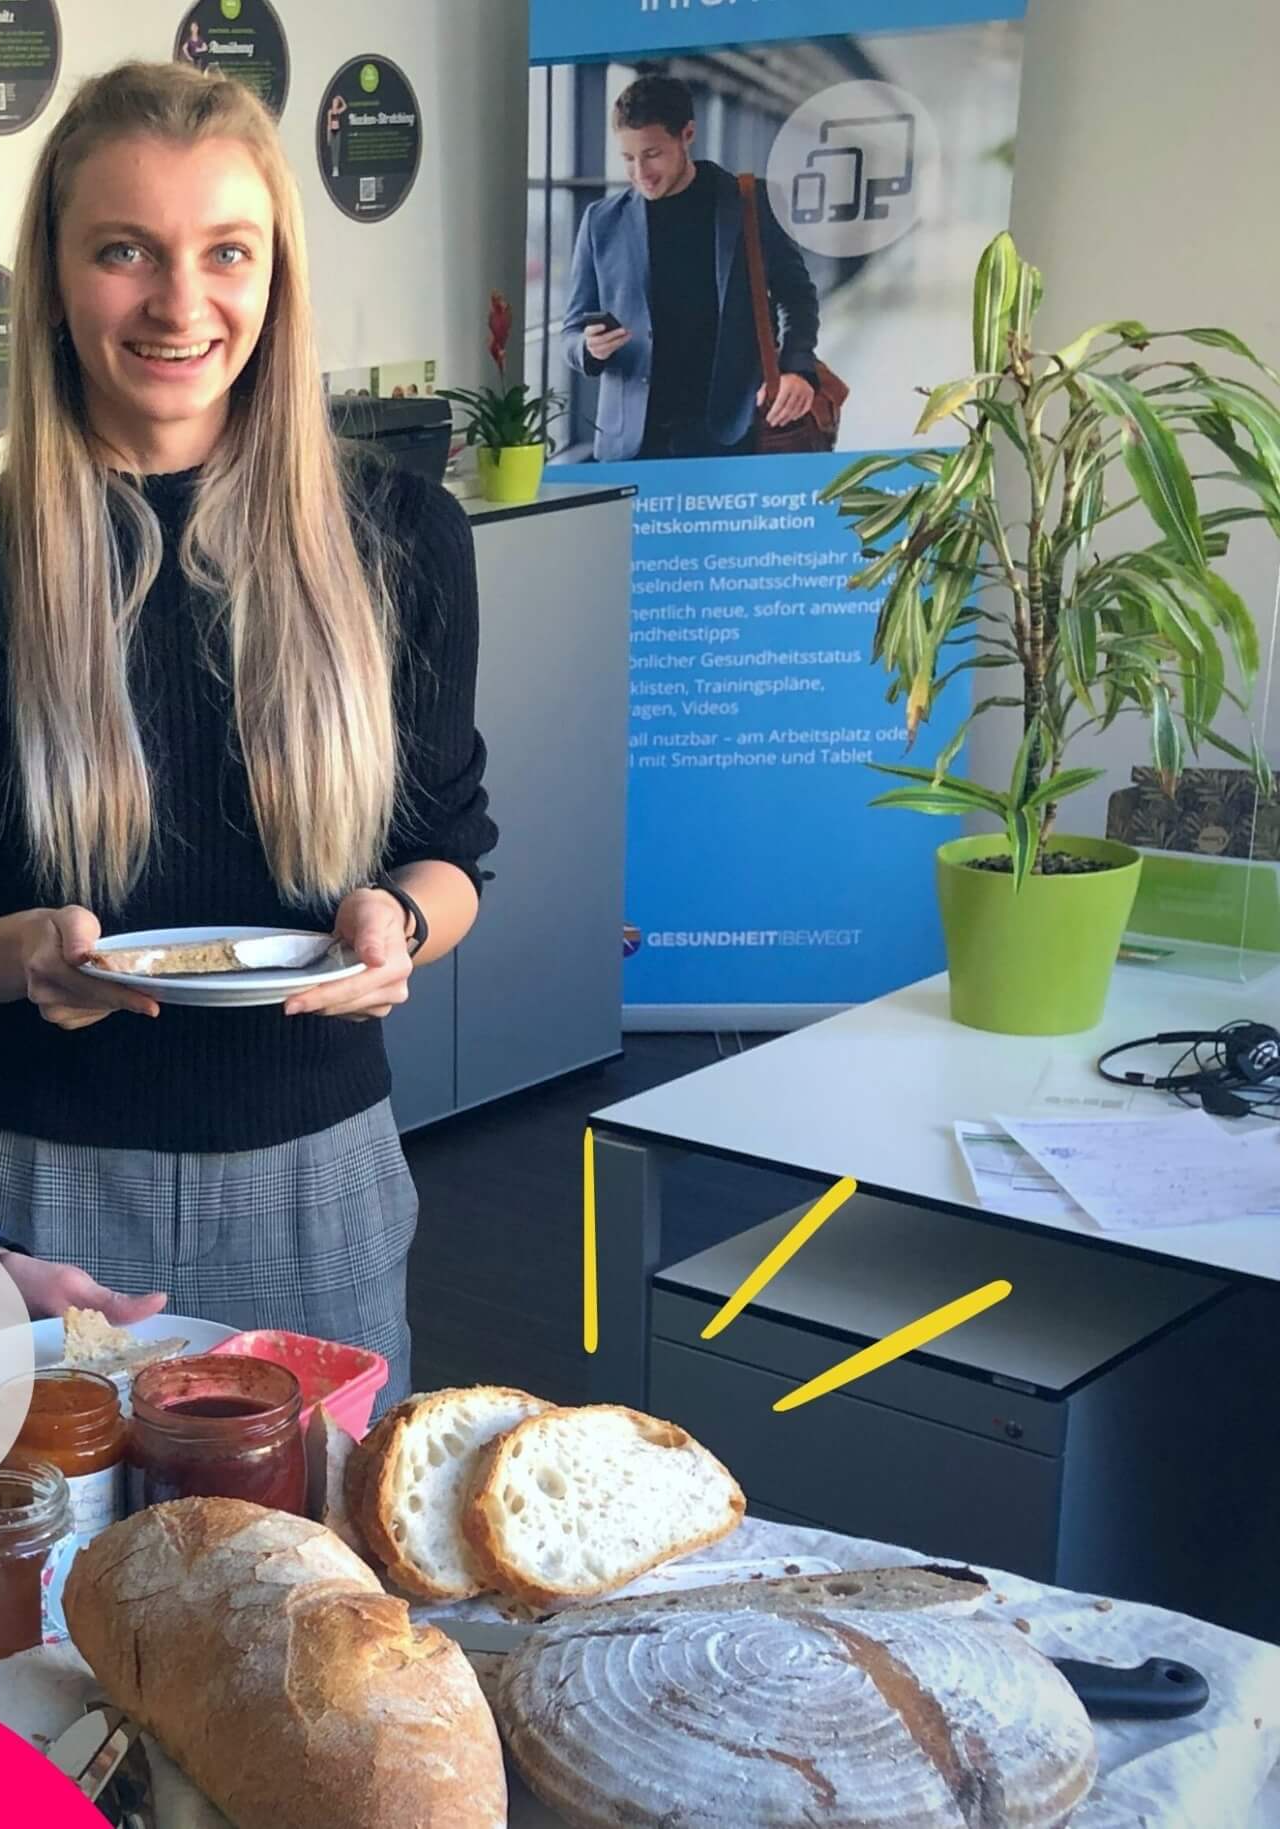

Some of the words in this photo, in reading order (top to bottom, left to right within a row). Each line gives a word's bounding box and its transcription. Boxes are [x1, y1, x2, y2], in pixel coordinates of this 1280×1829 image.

[631, 492, 758, 513] HEIT|BEWEGT
[761, 493, 812, 511] sorgt
[632, 555, 699, 572] nendes
[703, 550, 848, 570] Gesundheitsjahr
[702, 604, 749, 619] neue,
[754, 601, 805, 617] sofort
[630, 626, 740, 645] ndheitstipps
[701, 648, 862, 668] Gesundheitsstatus
[694, 676, 825, 696] Trainingspläne,
[681, 700, 739, 716] Videos
[652, 730, 719, 746] nutzbar
[736, 732, 764, 746] am
[768, 727, 871, 746] Arbeitsplatz
[875, 726, 908, 743] ode
[638, 752, 666, 767] mit
[671, 752, 776, 770] Smartphone
[782, 751, 815, 766] und
[822, 748, 873, 765] Tablet
